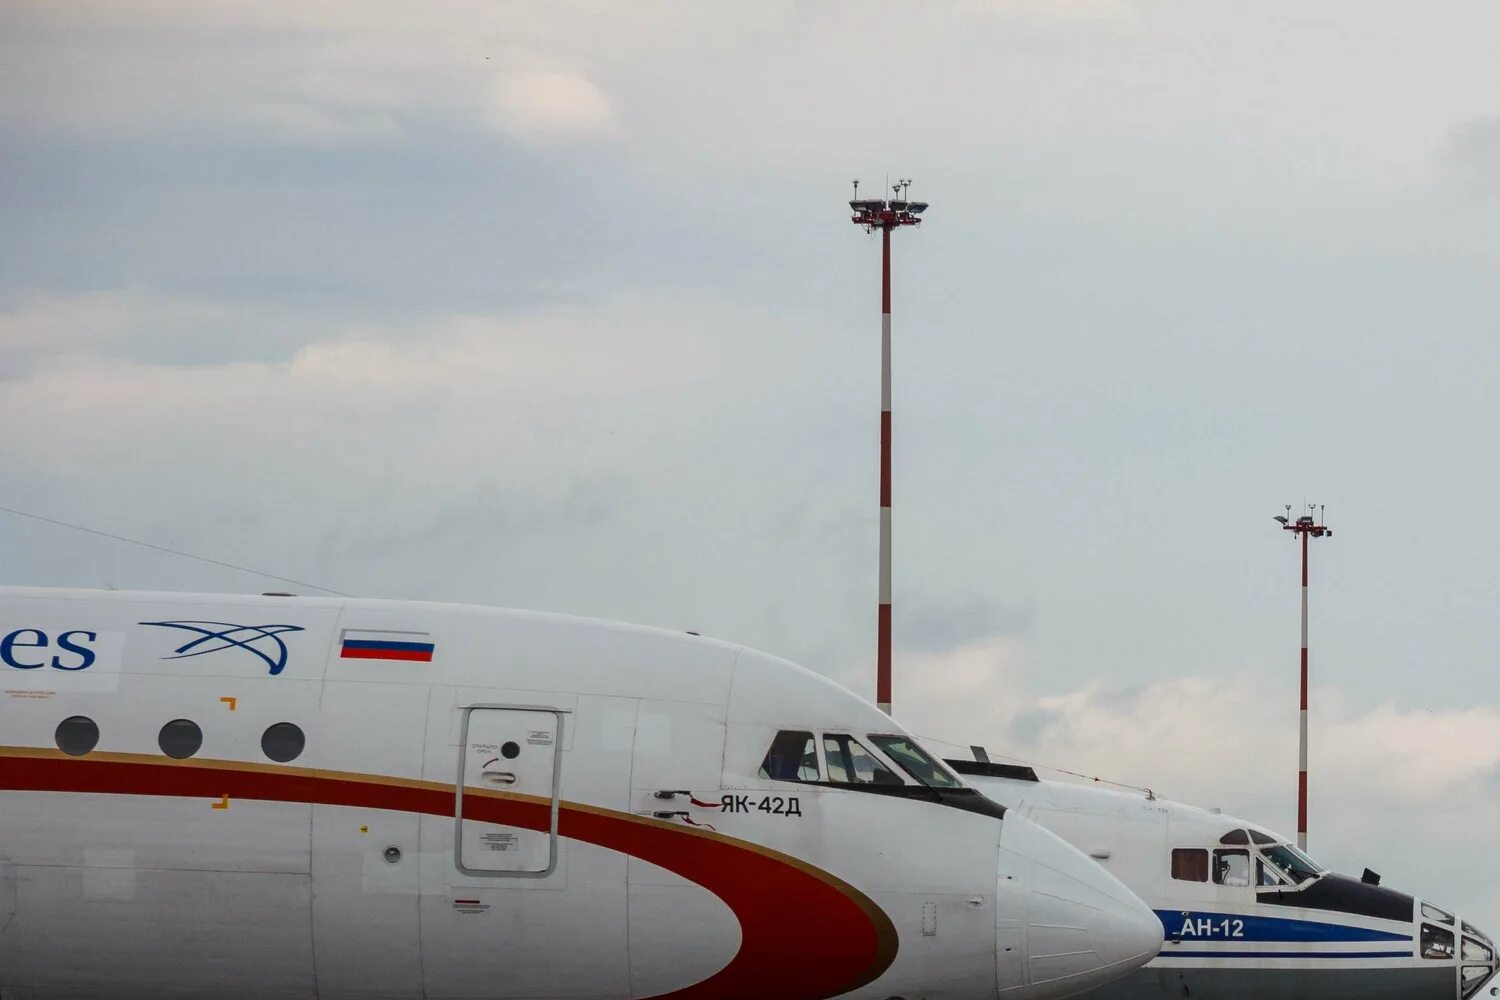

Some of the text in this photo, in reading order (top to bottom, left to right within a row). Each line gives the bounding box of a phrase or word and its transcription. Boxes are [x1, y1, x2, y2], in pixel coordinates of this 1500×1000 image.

[0, 629, 97, 671] es
[721, 795, 802, 817] ЯК-42Д
[1181, 918, 1244, 937] АН-12
